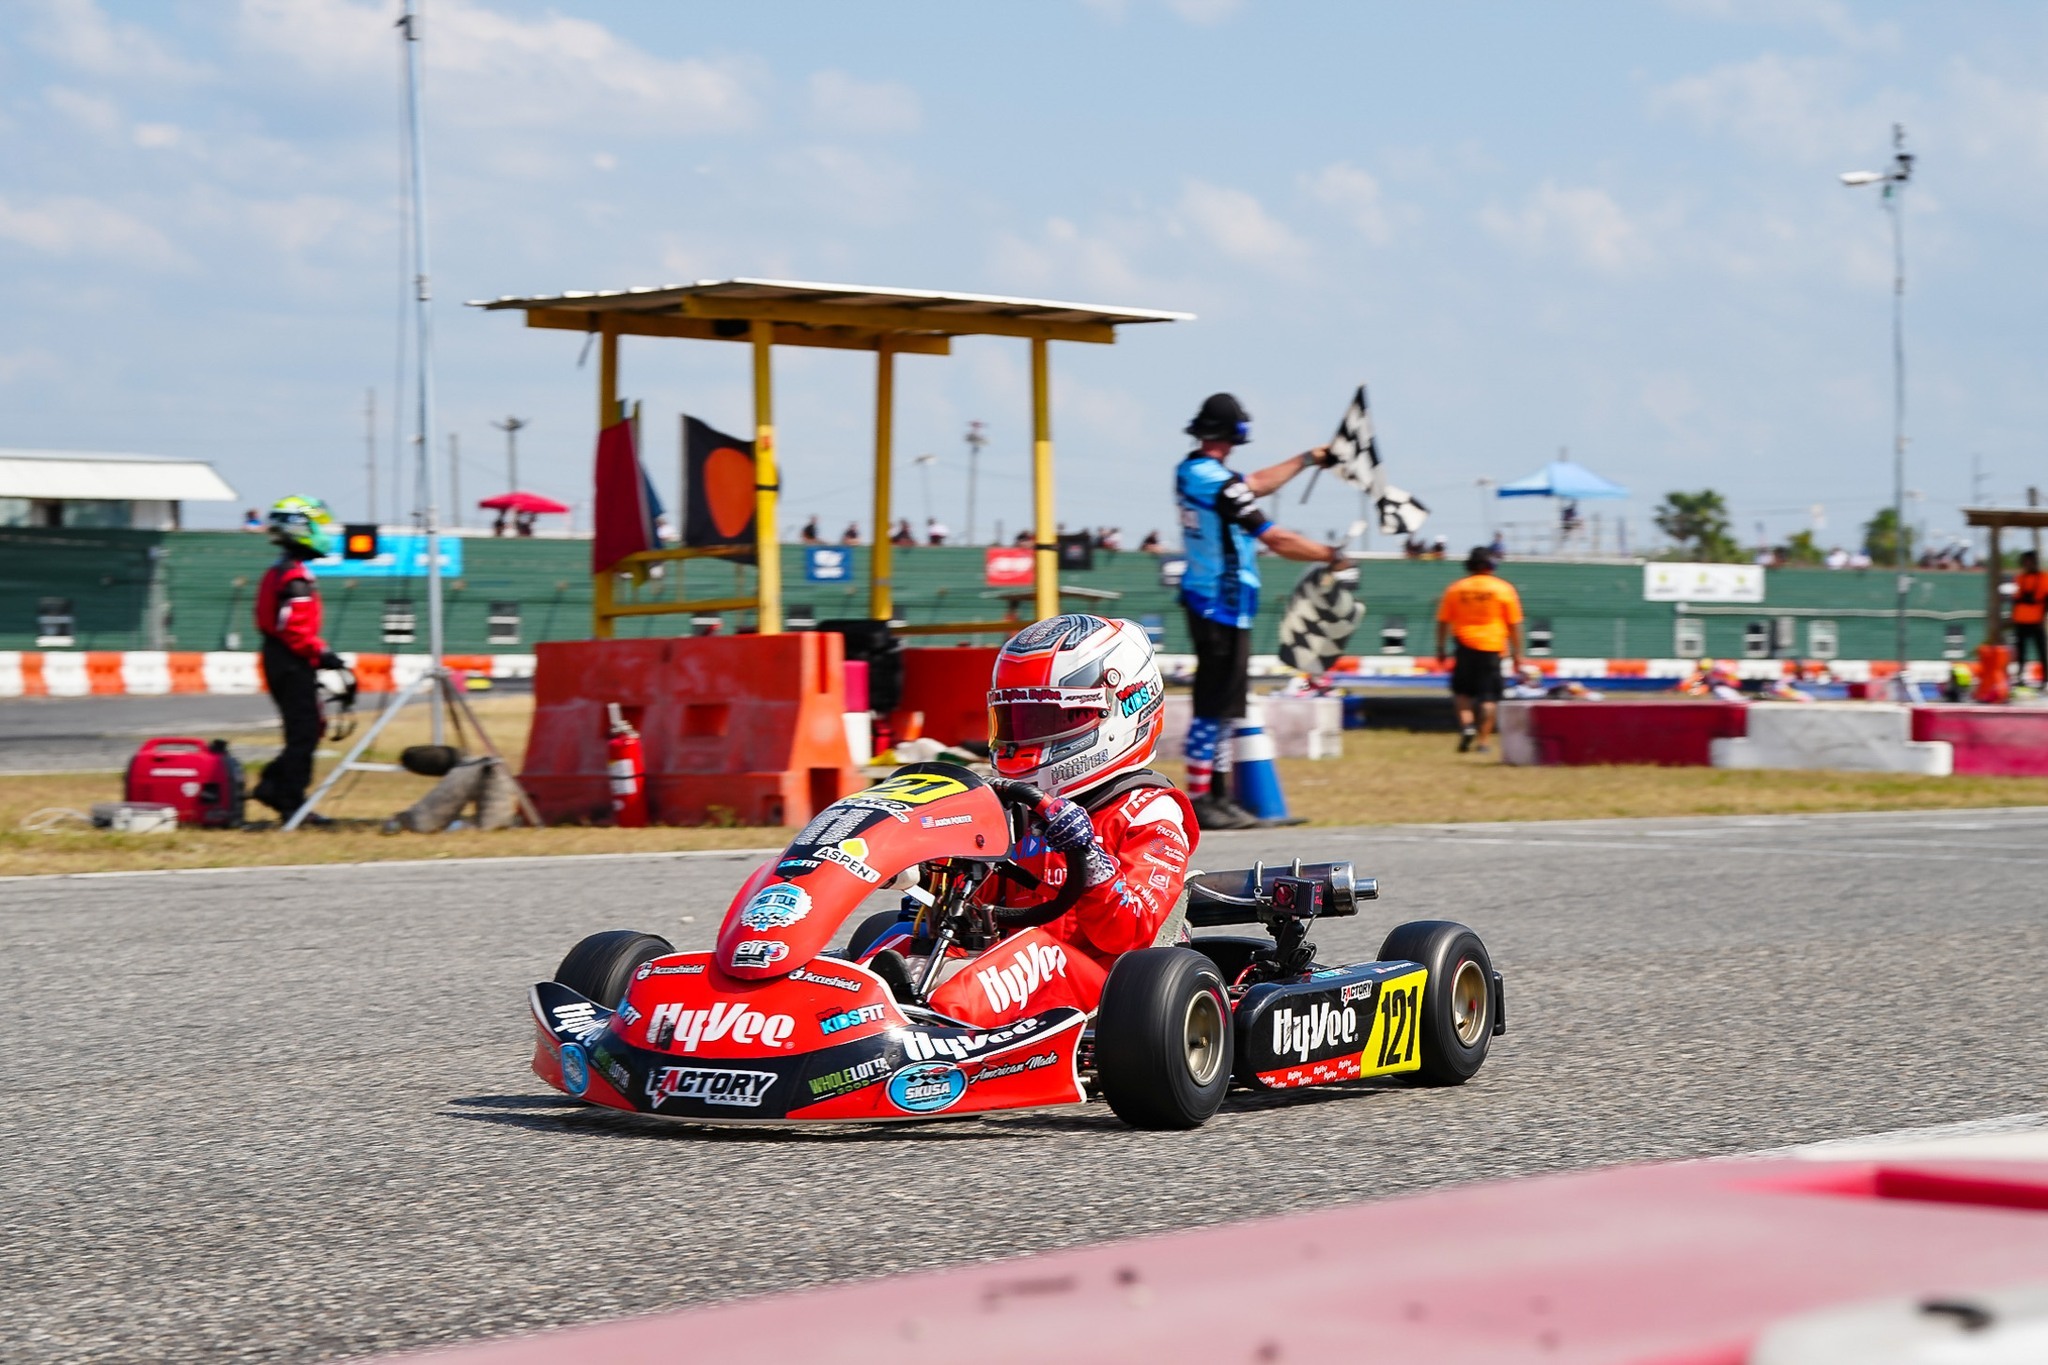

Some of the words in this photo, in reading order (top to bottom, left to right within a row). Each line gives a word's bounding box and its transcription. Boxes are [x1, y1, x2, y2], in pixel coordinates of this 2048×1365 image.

[740, 942, 770, 955] elf
[1342, 981, 1372, 999] FACTORY
[1377, 986, 1418, 1068] 121
[969, 1063, 1025, 1084] American
[1025, 1052, 1058, 1069] Made
[650, 1069, 774, 1097] FACTORY
[905, 1082, 951, 1099] SKUSA
